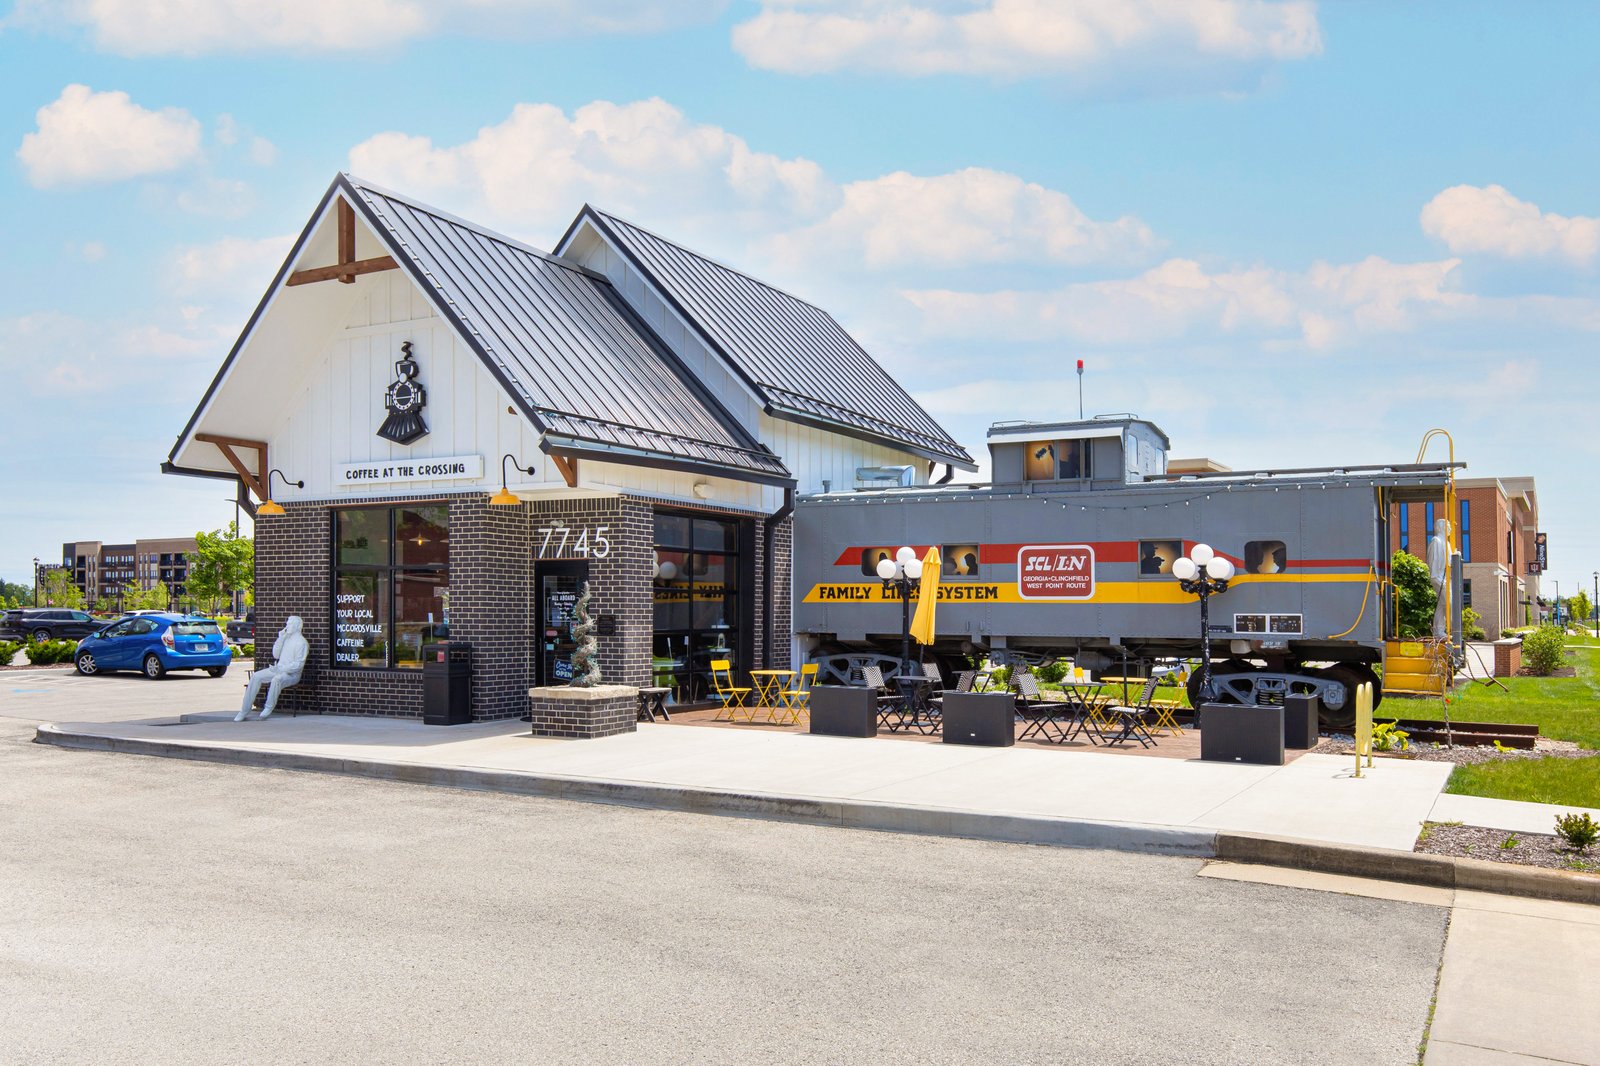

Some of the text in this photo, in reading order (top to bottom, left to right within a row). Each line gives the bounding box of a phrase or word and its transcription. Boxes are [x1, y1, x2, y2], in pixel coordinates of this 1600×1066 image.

[346, 463, 465, 479] COFFEE AT THE CROSSING
[538, 527, 609, 559] 7745
[819, 586, 872, 600] FAMILY
[936, 586, 999, 600] SYSTEM
[337, 595, 365, 603] SUPPORT
[337, 610, 373, 618] YOUR LOCAL
[337, 624, 382, 633] MCCORDSVILLE
[337, 639, 364, 647] CAFFEINE
[555, 670, 573, 678] OPEN
